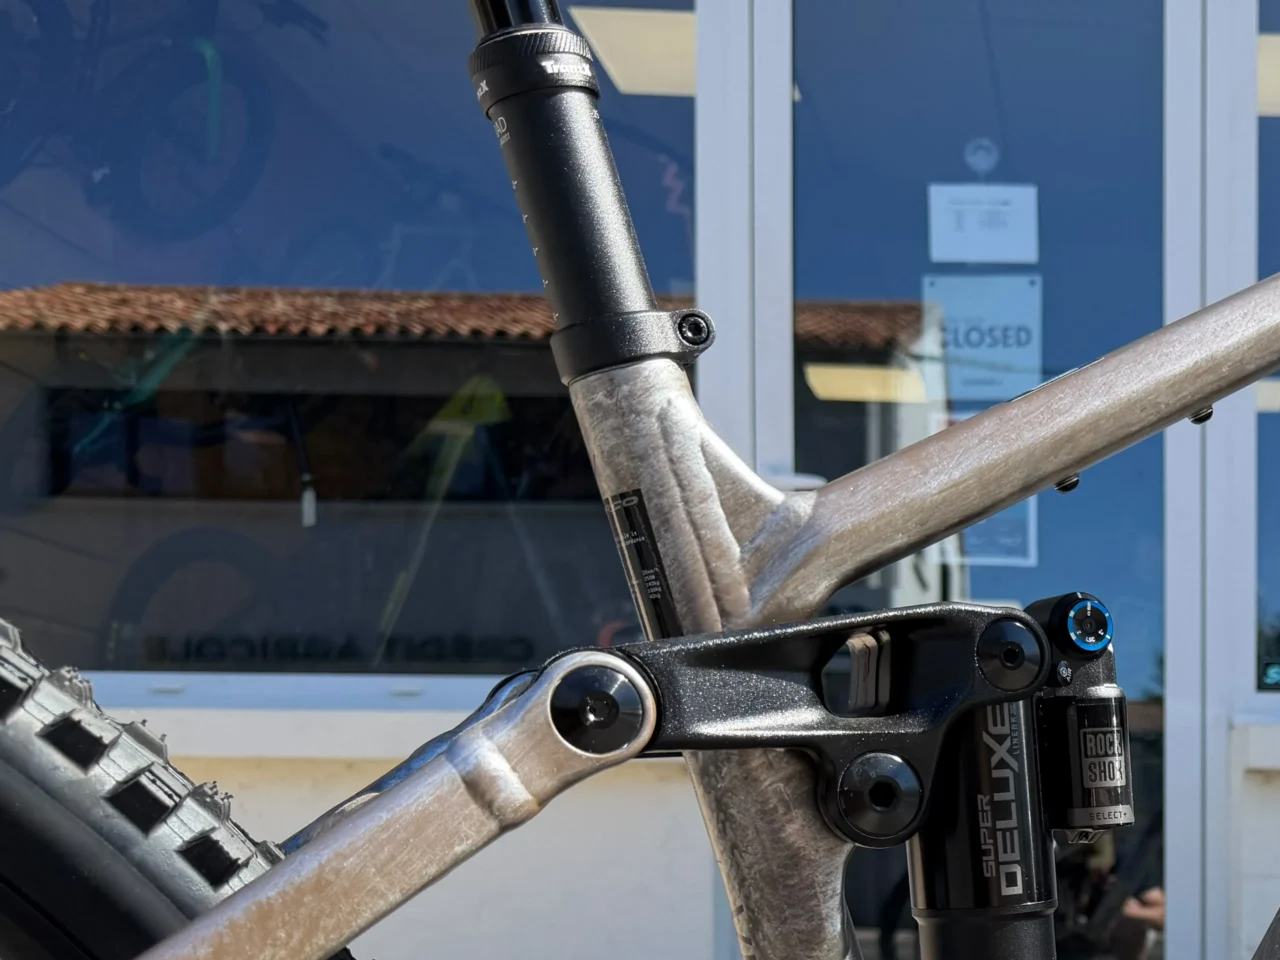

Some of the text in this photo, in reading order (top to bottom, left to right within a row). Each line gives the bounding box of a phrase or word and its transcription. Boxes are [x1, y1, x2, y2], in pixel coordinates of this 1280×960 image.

[1086, 732, 1123, 757] ROCK
[977, 794, 996, 878] SUPER
[983, 702, 1024, 896] DELUXE
